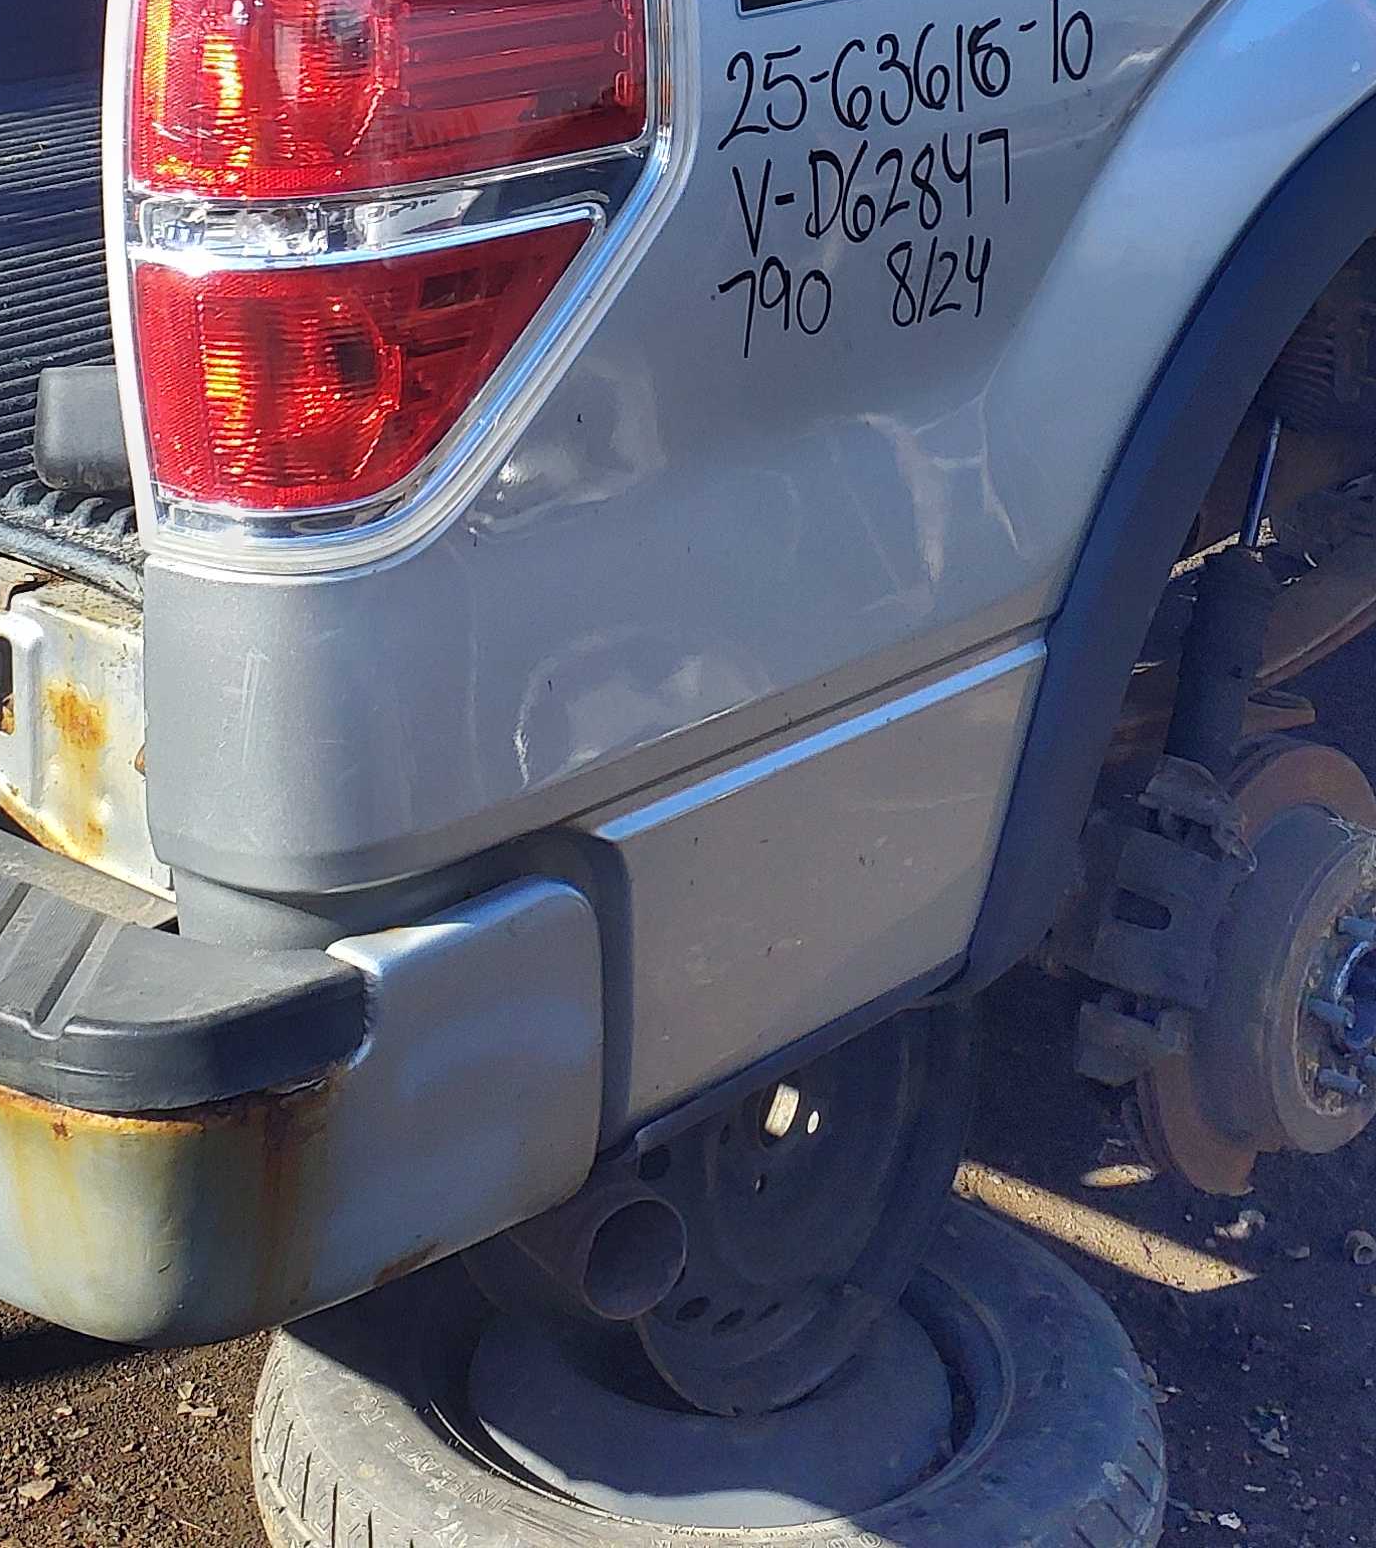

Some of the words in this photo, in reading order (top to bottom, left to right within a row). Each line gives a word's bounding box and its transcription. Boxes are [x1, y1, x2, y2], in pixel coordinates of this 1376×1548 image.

[732, 128, 1011, 257] V-D62847
[718, 256, 832, 358] 790
[886, 235, 992, 328] 8/24
